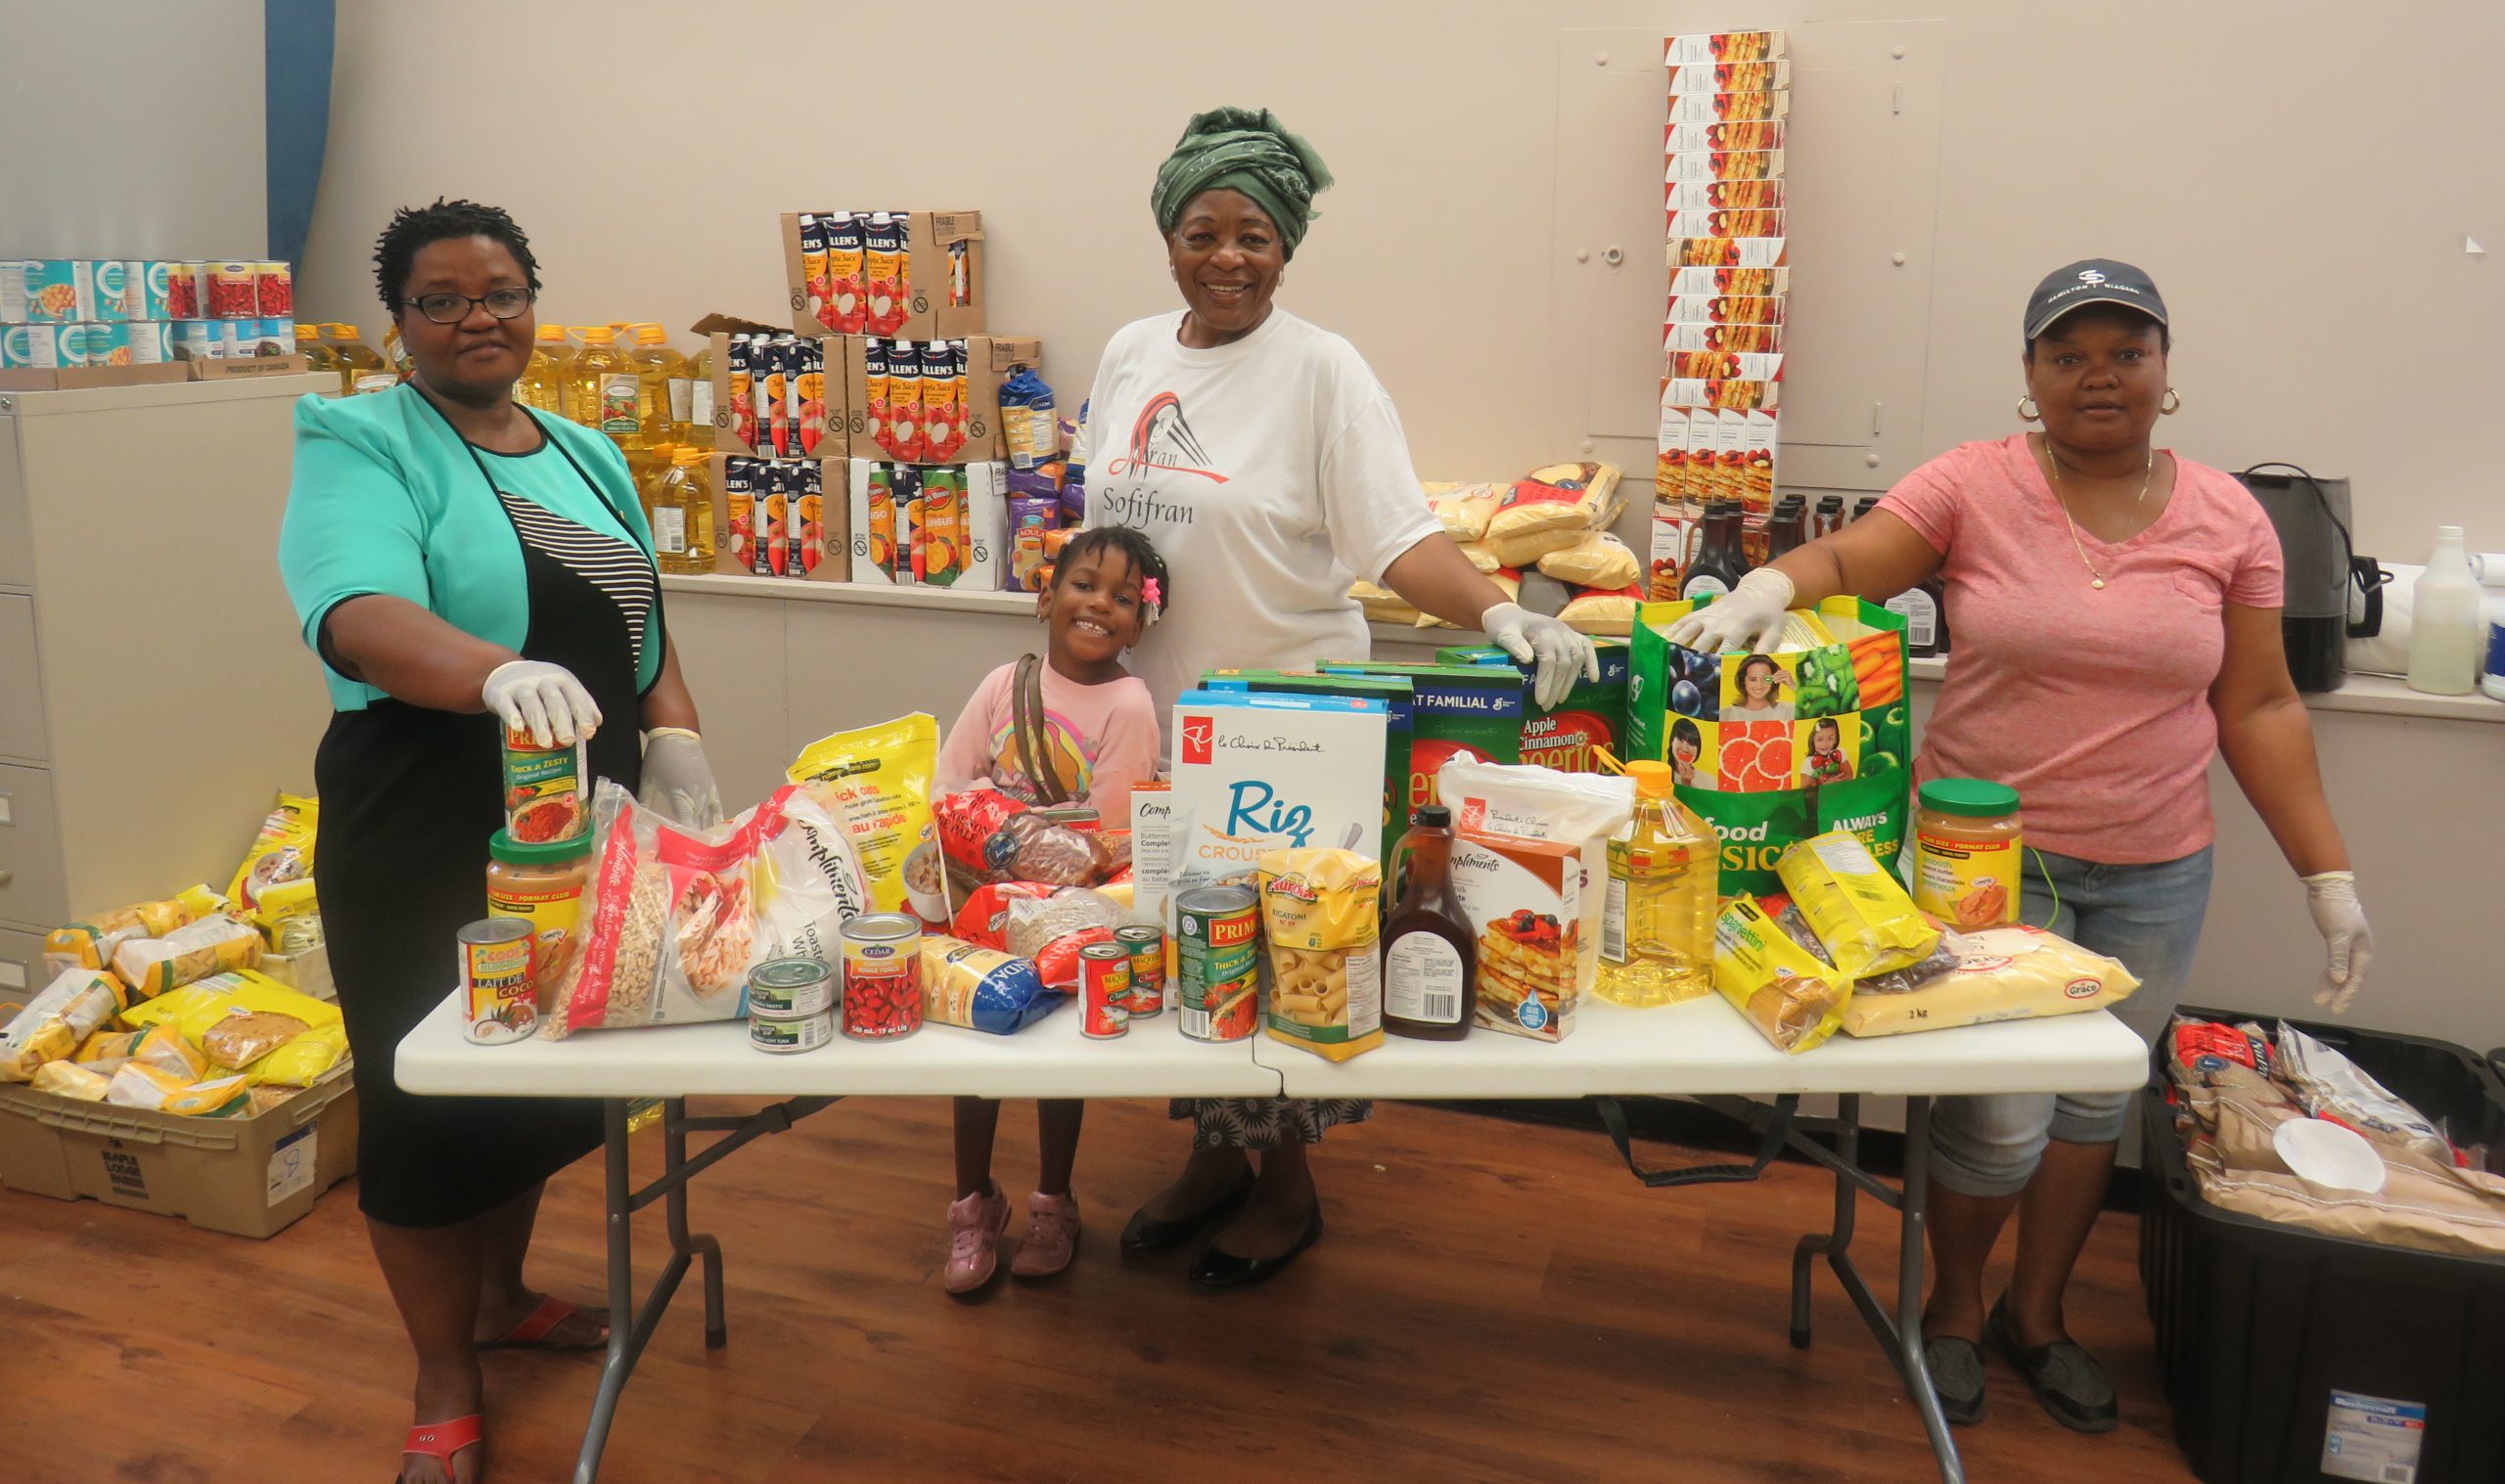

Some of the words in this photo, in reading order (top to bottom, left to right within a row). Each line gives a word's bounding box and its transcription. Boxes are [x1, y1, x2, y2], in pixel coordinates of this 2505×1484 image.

[803, 239, 822, 248] EN'S
[867, 362, 886, 372] EN'S
[1103, 486, 1195, 529] Sofifran
[1427, 694, 1487, 709] FAMILIAL
[1524, 716, 1557, 737] Apple
[1139, 802, 1171, 820] Comp
[1227, 780, 1314, 847] Riz
[852, 822, 870, 833] au
[1832, 811, 1888, 832] ALWAYS
[1214, 919, 1255, 940] PRIM
[478, 978, 505, 988] LAIT
[508, 974, 524, 984] DE
[499, 980, 534, 998] COCO
[2069, 983, 2098, 995] Grace
[1909, 1010, 1915, 1018] 2
[1916, 1009, 1928, 1018] kg
